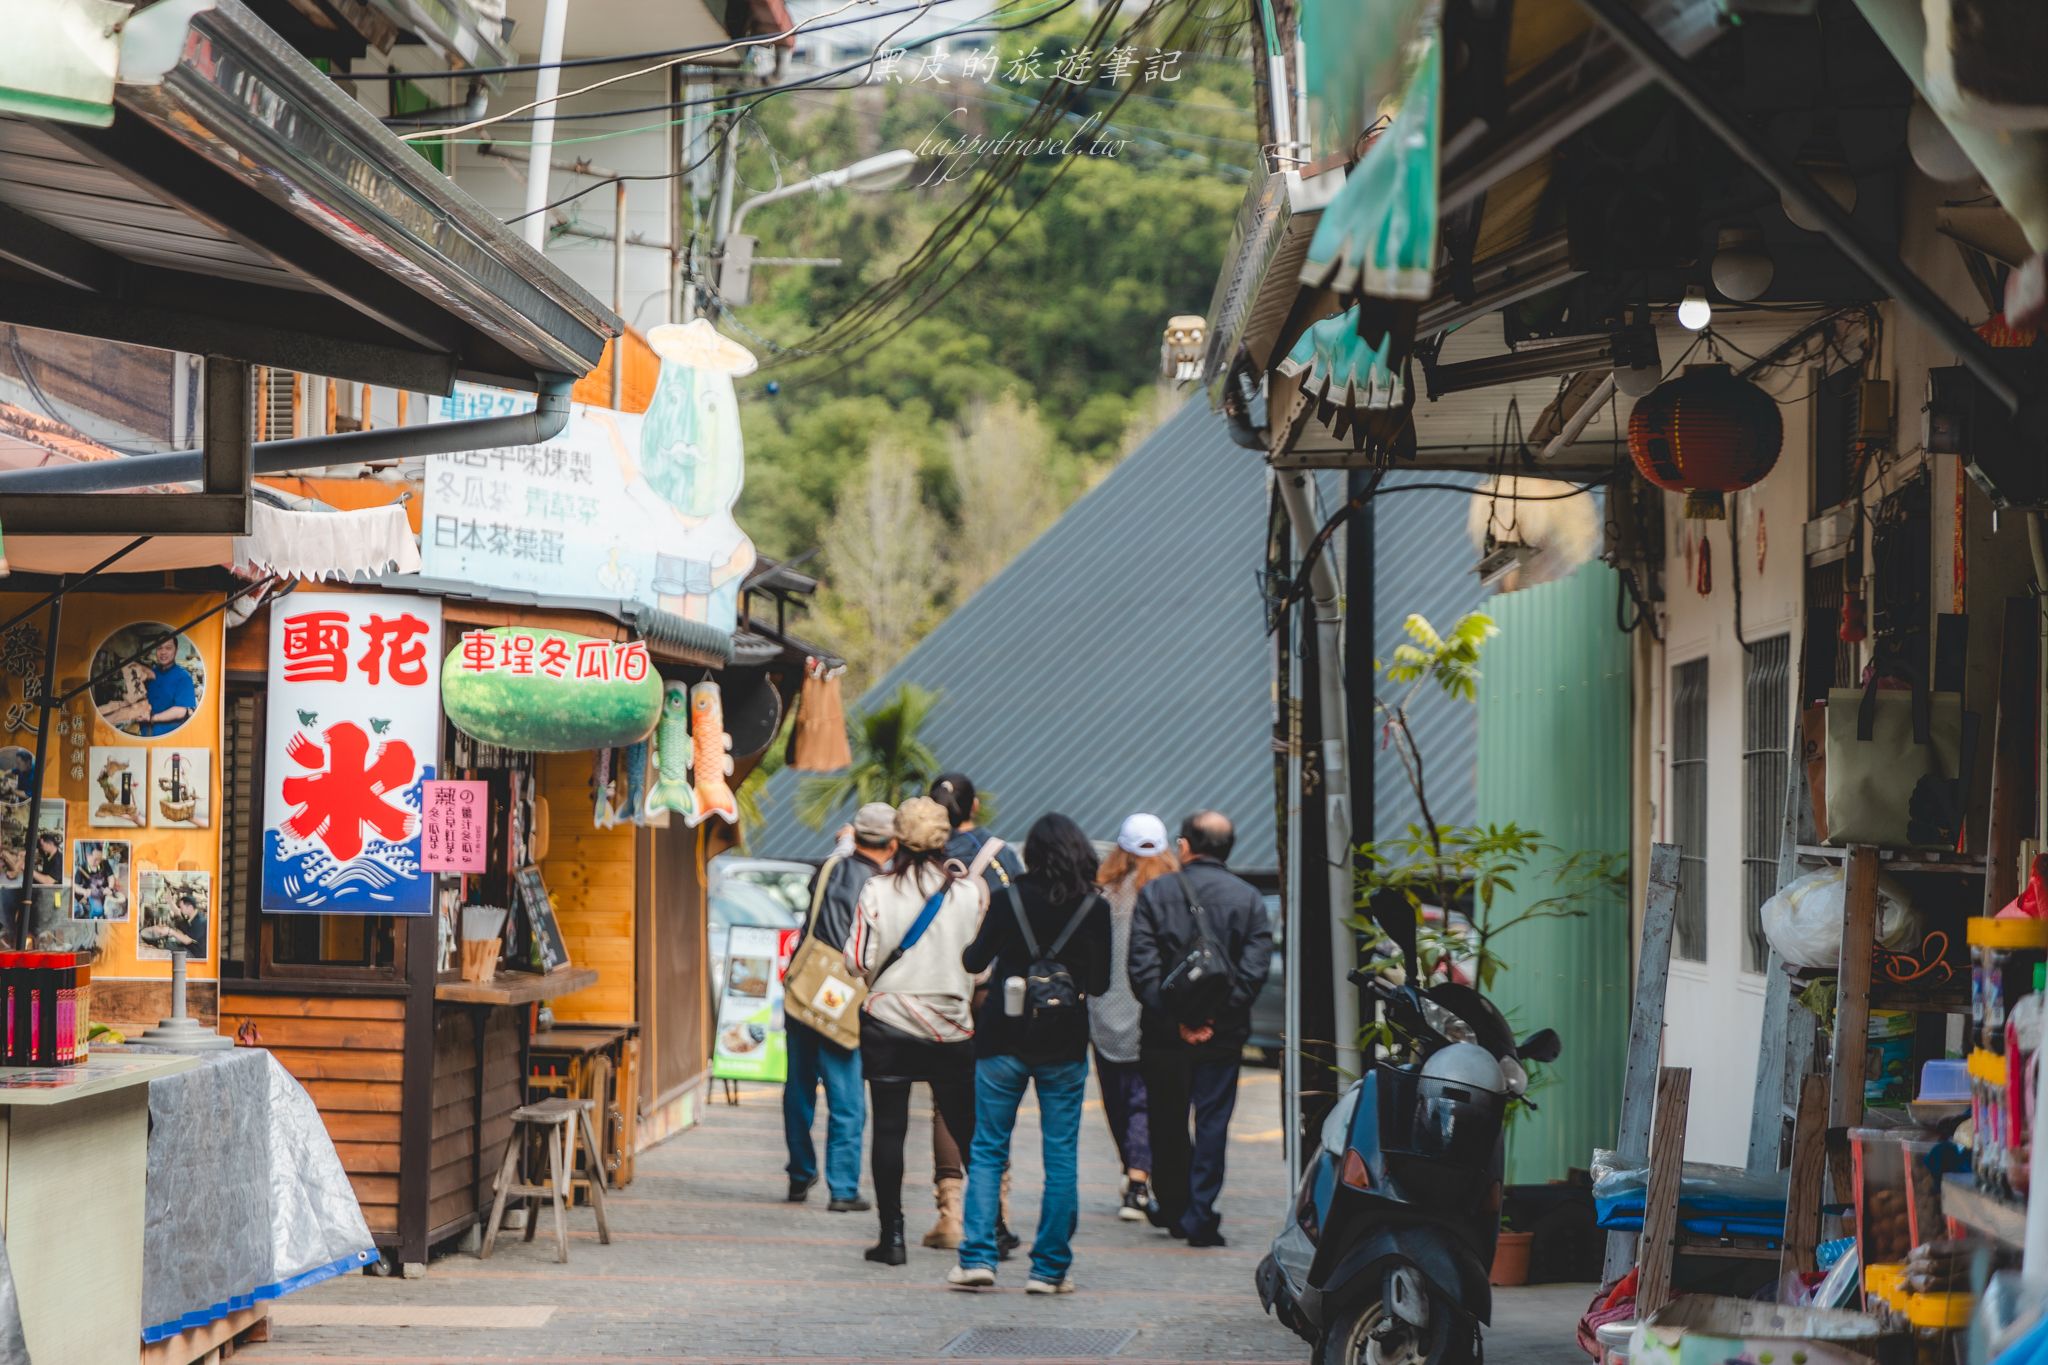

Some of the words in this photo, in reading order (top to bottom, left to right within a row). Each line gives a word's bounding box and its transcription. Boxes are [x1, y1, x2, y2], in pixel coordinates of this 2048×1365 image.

[435, 471, 514, 512] 冬瓜茶
[434, 514, 565, 565] 日本茶葉蛋
[283, 611, 430, 686] 雪花
[462, 631, 649, 683] 車埕冬瓜伯
